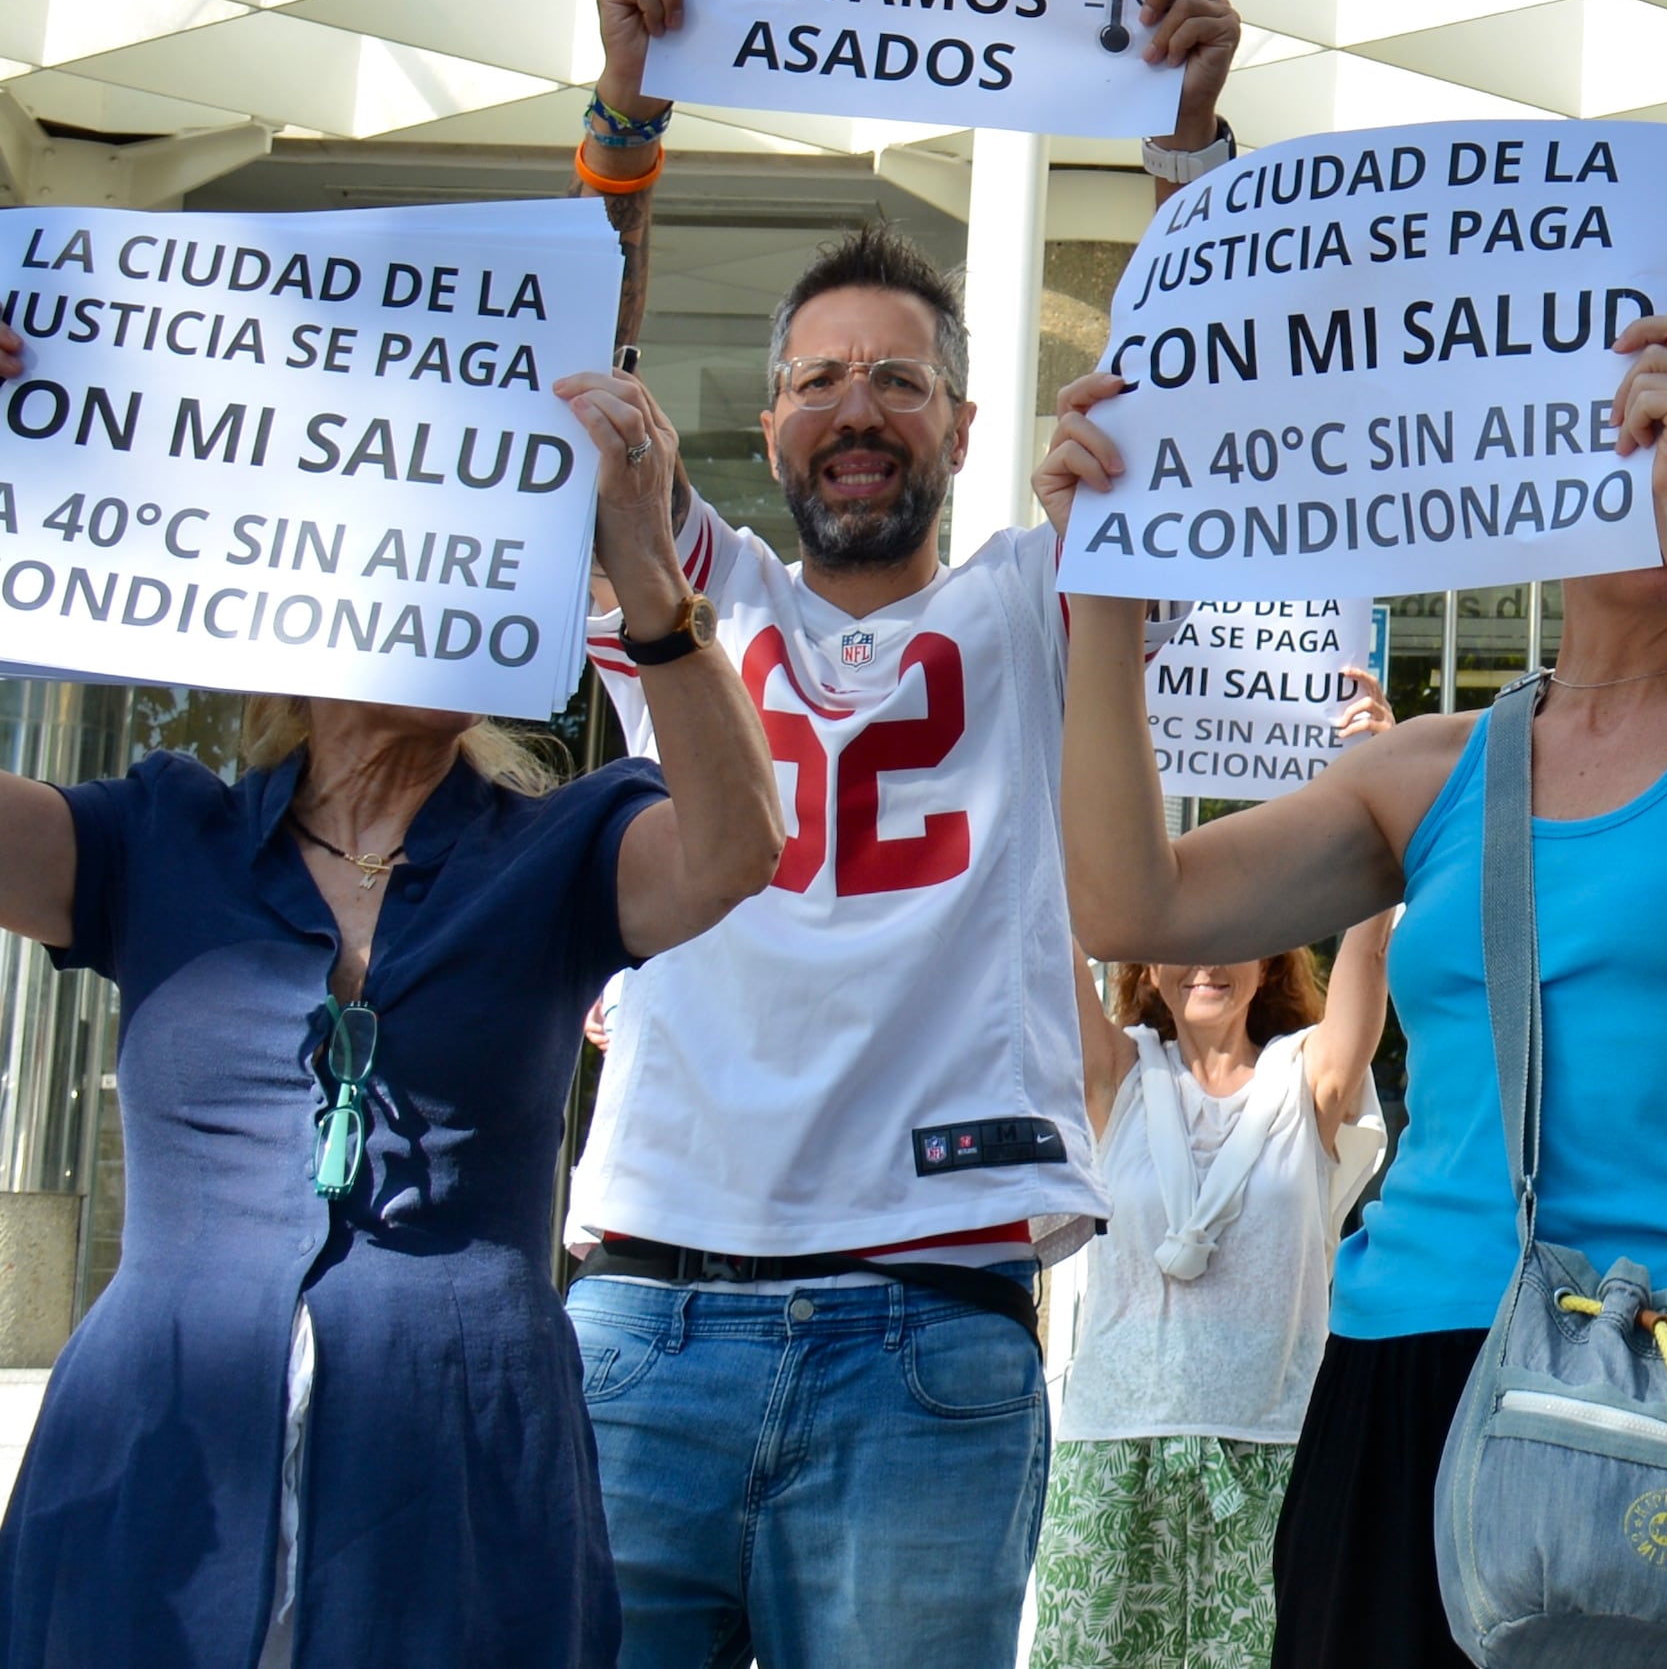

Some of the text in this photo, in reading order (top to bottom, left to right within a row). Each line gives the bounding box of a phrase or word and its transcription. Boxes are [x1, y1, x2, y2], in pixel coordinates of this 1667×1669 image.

[732, 21, 1015, 91] ASADOS
[1166, 141, 1619, 235] LA CIUDAD DE LA
[21, 228, 547, 321] LA CIUDAD DE LA
[1133, 206, 1612, 311] JUSTICIA SE PAGA
[286, 324, 358, 373] SE
[375, 332, 540, 392] PAGA
[1110, 288, 1655, 389] CON MI SALUD
[0, 379, 574, 493] ON MI SALUD
[1149, 400, 1618, 491] A 40°C SIN AIRE
[42, 493, 209, 559] 40°C
[226, 515, 345, 573] SIN
[361, 529, 524, 591] AIRE
[1085, 470, 1633, 559] ACONDICIONADO
[845, 645, 870, 662] NFL
[1210, 625, 1244, 649] SE
[1256, 628, 1340, 653] PAGA
[1158, 665, 1359, 704] MI SALUD
[1195, 718, 1253, 743] SIN
[1265, 723, 1344, 750] AIRE
